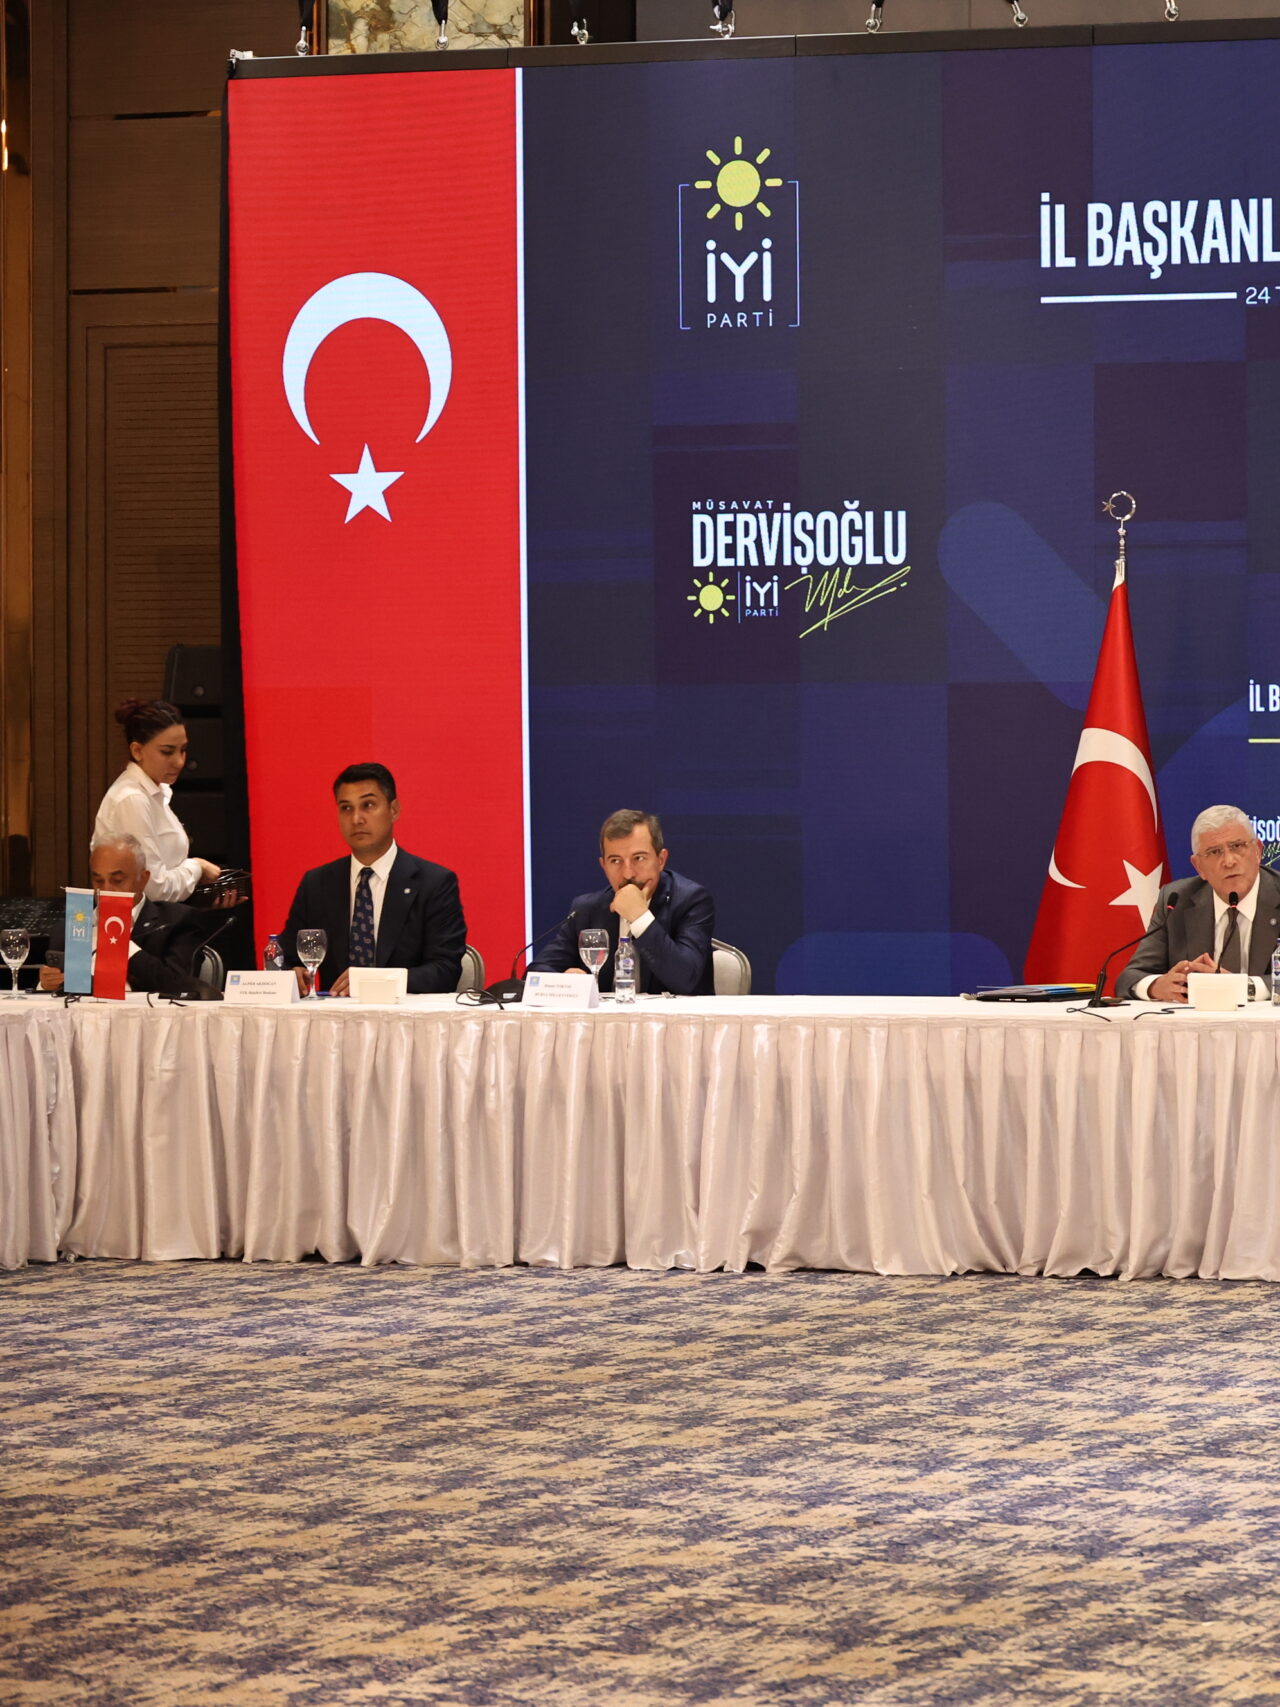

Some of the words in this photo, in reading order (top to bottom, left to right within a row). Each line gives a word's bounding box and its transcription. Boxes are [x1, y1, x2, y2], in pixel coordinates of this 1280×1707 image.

[1040, 192, 1077, 268] İL
[705, 237, 773, 304] İYİ
[1245, 286, 1271, 305] 24
[706, 308, 773, 329] PARTİ
[692, 499, 774, 511] MÜSAVAT
[692, 500, 907, 574] DERVİŞOĞLU
[745, 575, 779, 607] İYİ
[745, 607, 779, 617] PARTİ
[1249, 679, 1265, 712] İL
